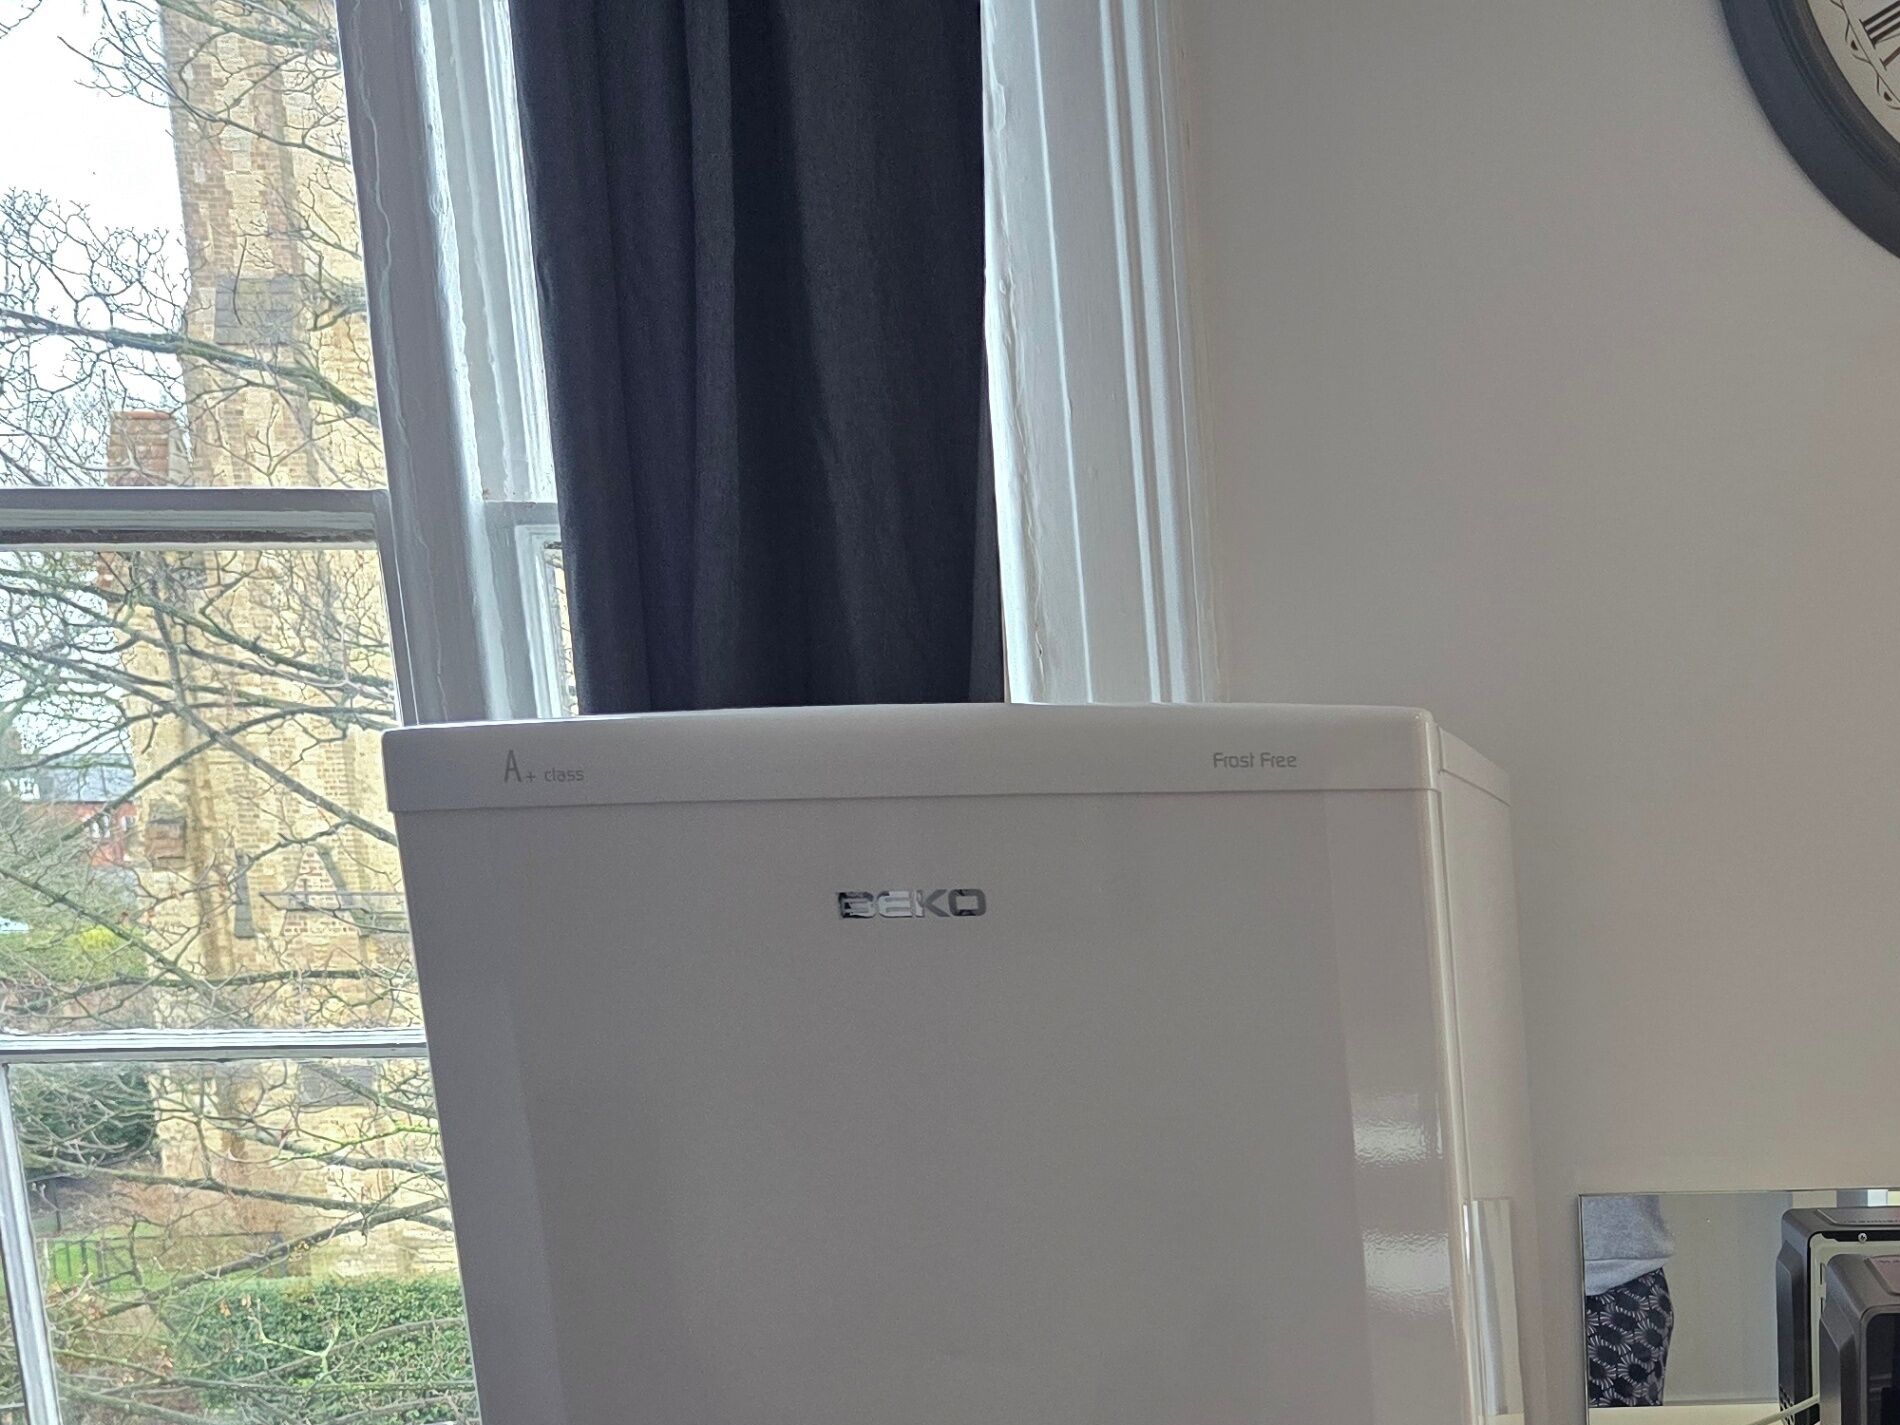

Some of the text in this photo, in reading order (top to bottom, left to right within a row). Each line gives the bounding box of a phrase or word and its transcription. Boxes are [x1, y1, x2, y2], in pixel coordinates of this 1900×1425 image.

[1213, 751, 1297, 768] Frost Free
[544, 767, 585, 782] class
[838, 888, 987, 918] BEKO
